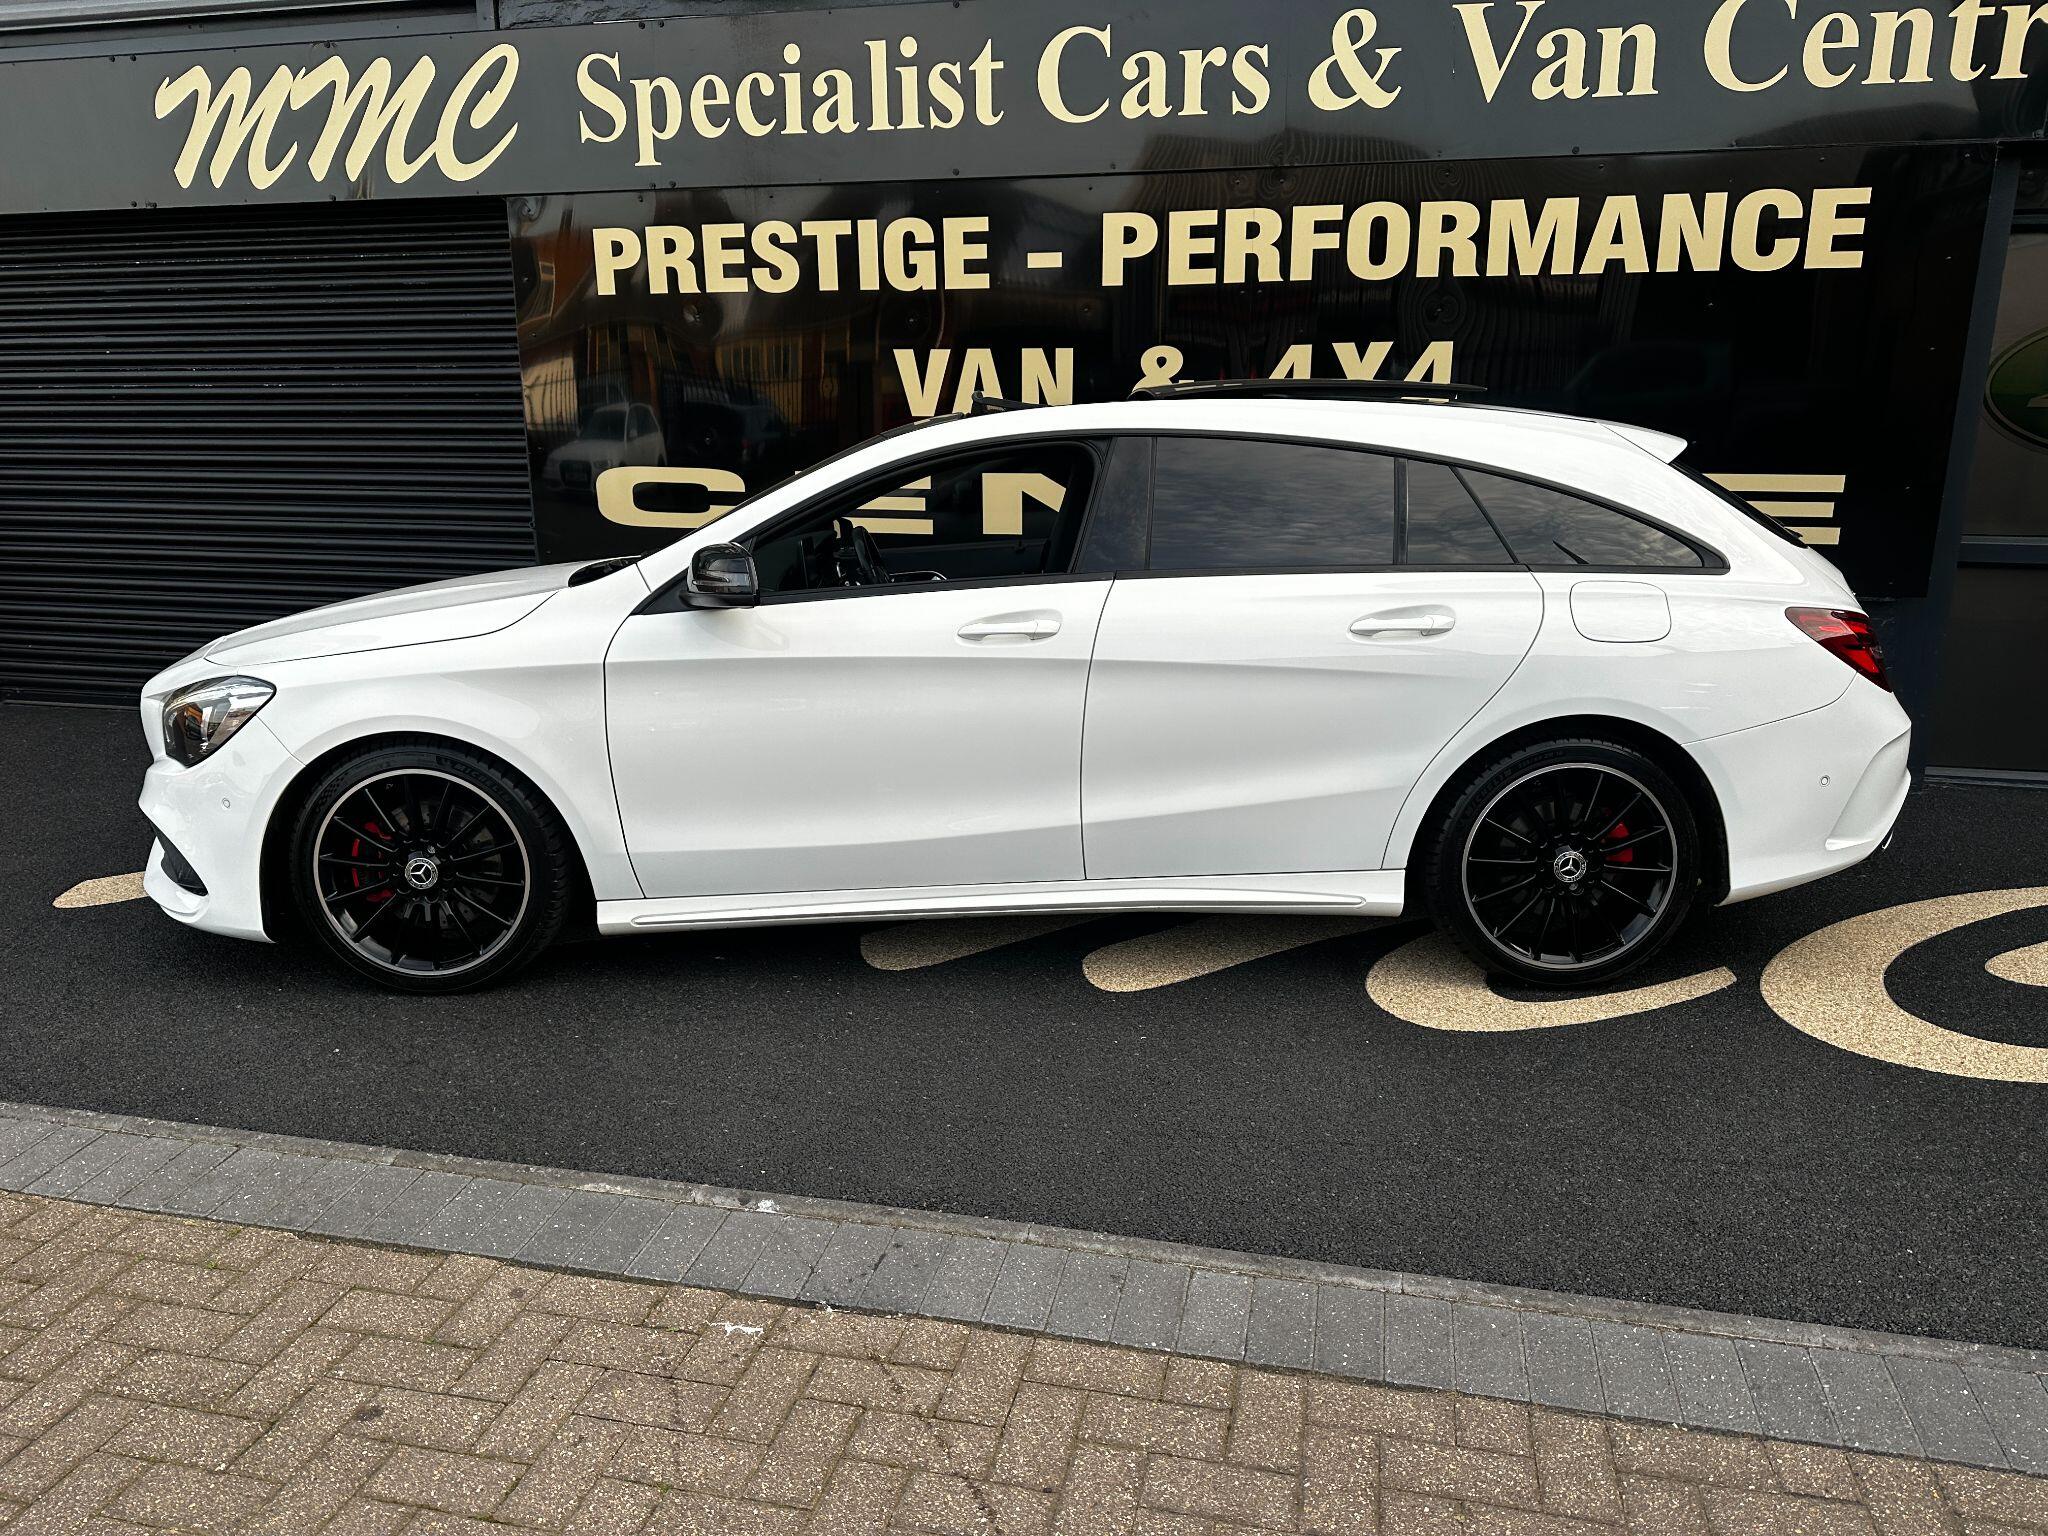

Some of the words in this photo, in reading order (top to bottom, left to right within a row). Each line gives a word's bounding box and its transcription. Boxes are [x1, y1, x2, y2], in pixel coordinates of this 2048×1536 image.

[155, 44, 519, 189] MMC
[577, 36, 1004, 167] Specialist
[1037, 25, 1270, 124] Cars
[1308, 9, 1401, 111] &
[1453, 0, 1658, 104] Van
[593, 216, 990, 296] PRESTIGE
[1027, 252, 1063, 269] -
[1101, 187, 1872, 287] PERFORMANCE
[893, 347, 1074, 417] VAN
